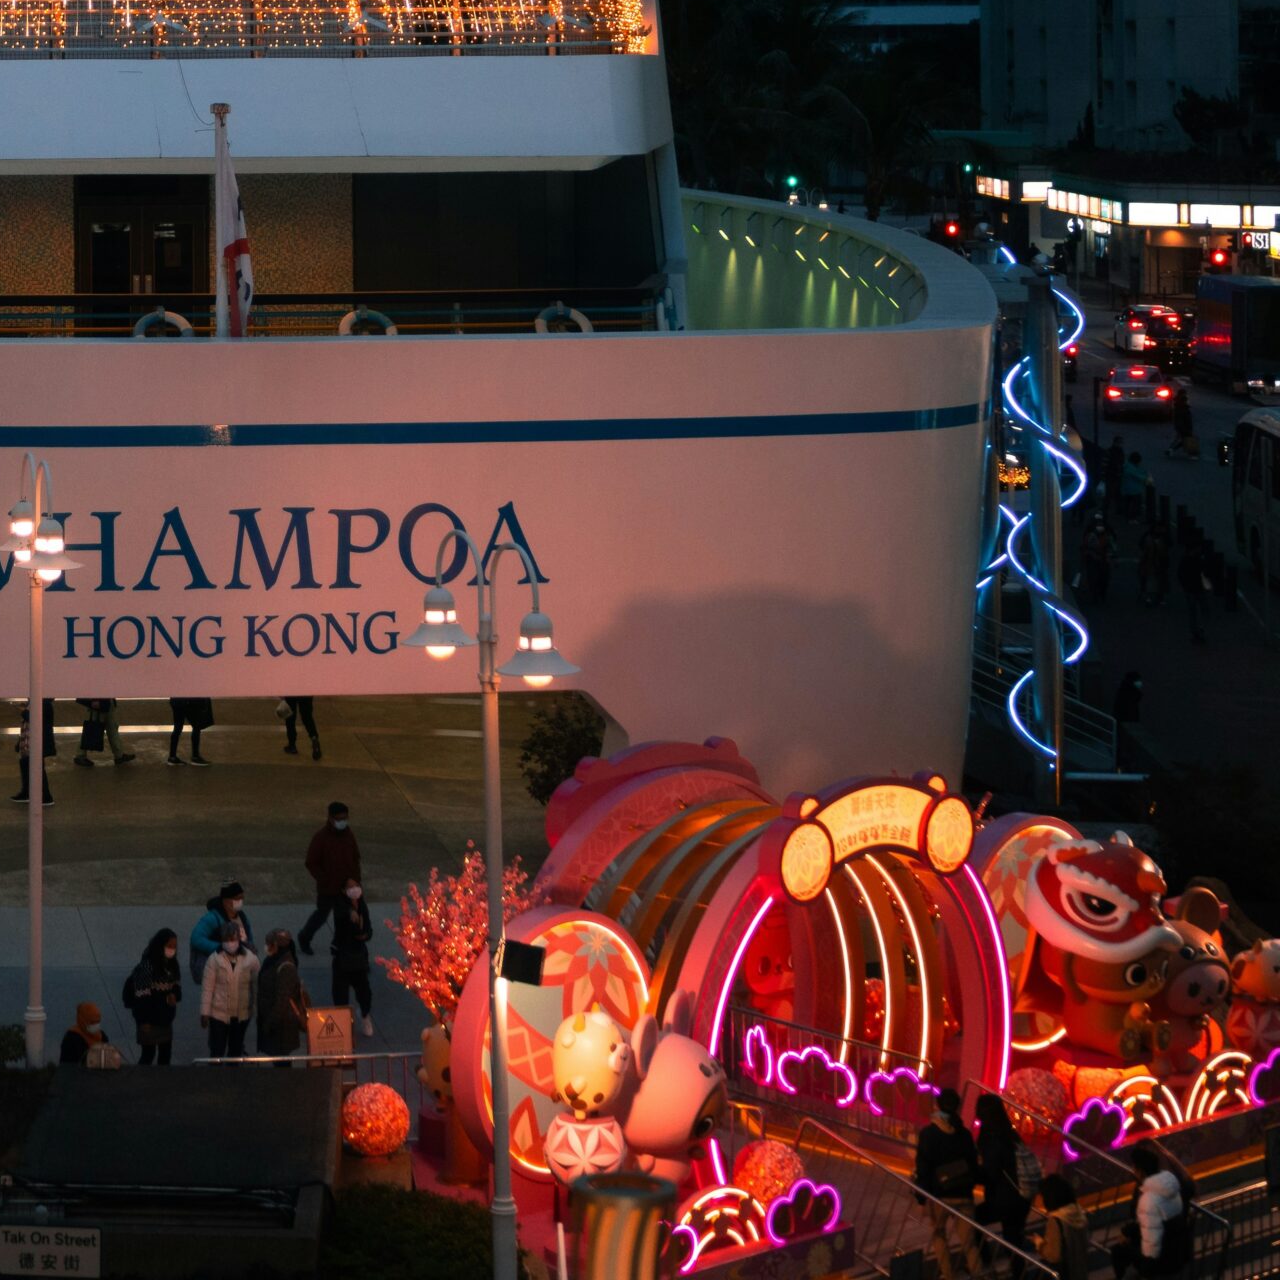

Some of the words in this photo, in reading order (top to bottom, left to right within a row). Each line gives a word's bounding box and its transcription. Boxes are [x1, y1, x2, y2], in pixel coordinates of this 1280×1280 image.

[62, 614, 226, 660] HONG
[243, 610, 401, 658] KONG
[2, 1230, 26, 1245] Tak
[30, 1231, 50, 1245] On
[54, 1232, 97, 1247] Street
[18, 1252, 81, 1271] 德安街
